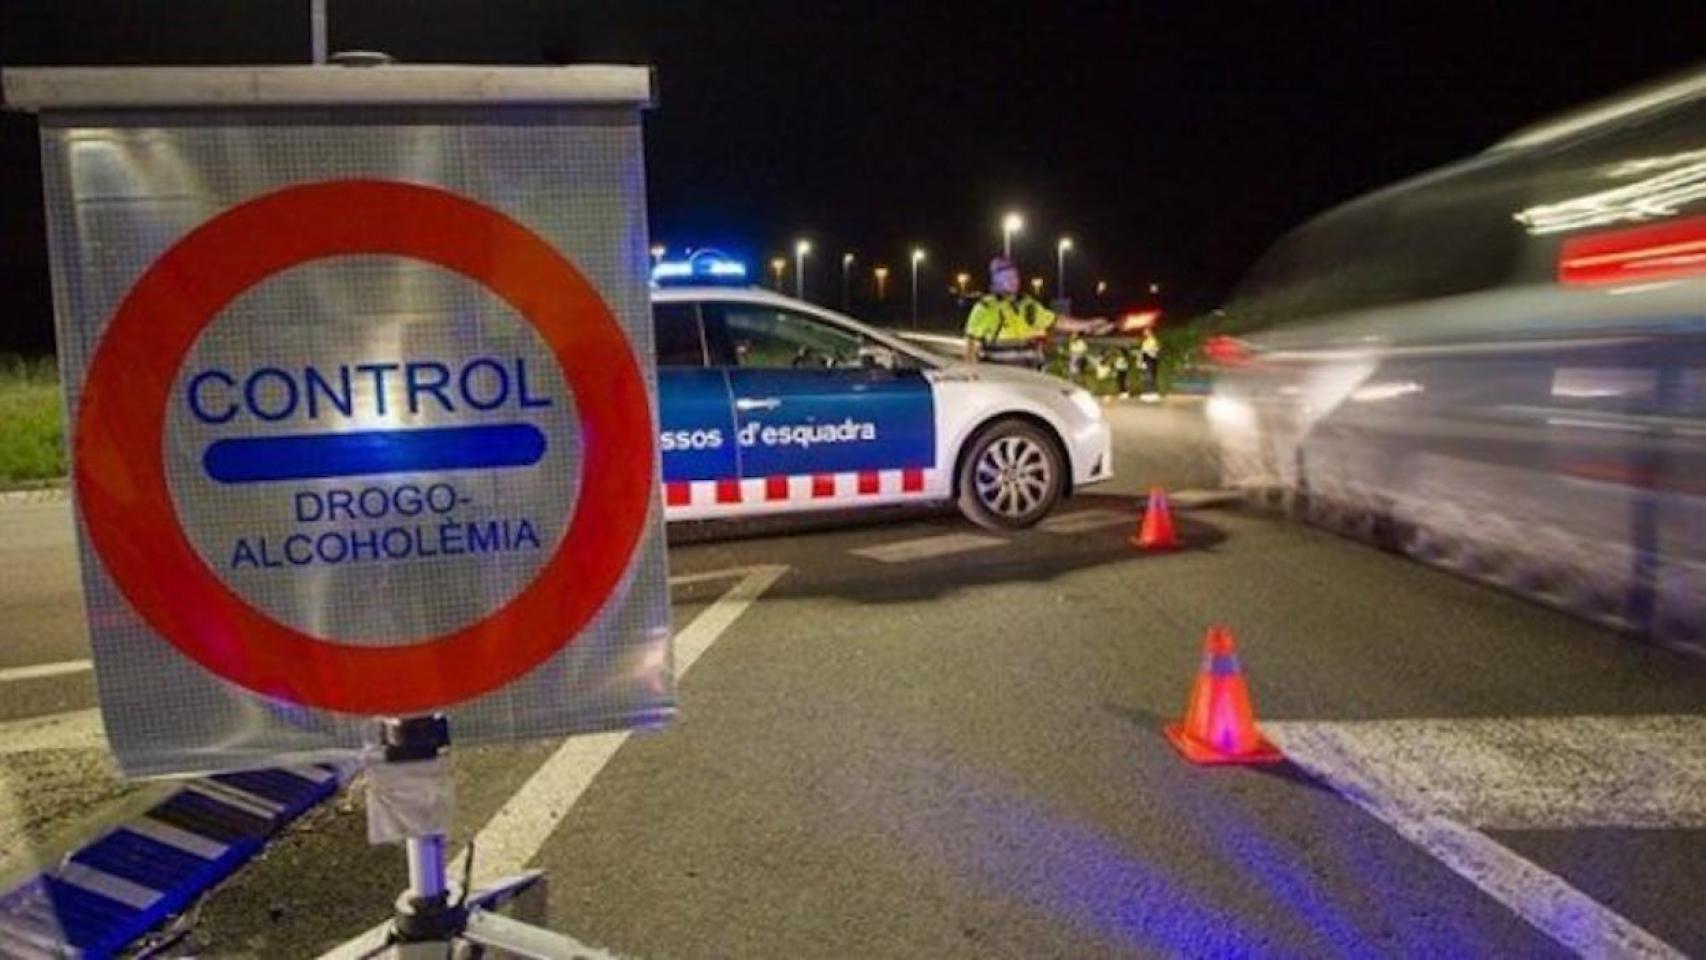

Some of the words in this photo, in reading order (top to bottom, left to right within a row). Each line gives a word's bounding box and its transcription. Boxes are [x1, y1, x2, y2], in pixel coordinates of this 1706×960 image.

[187, 356, 553, 425] CONTROL
[660, 428, 723, 450] ssos
[738, 418, 877, 448] d'esquadra
[294, 483, 471, 522] DROGO-
[231, 517, 541, 569] ALCOHOLÈMIA
